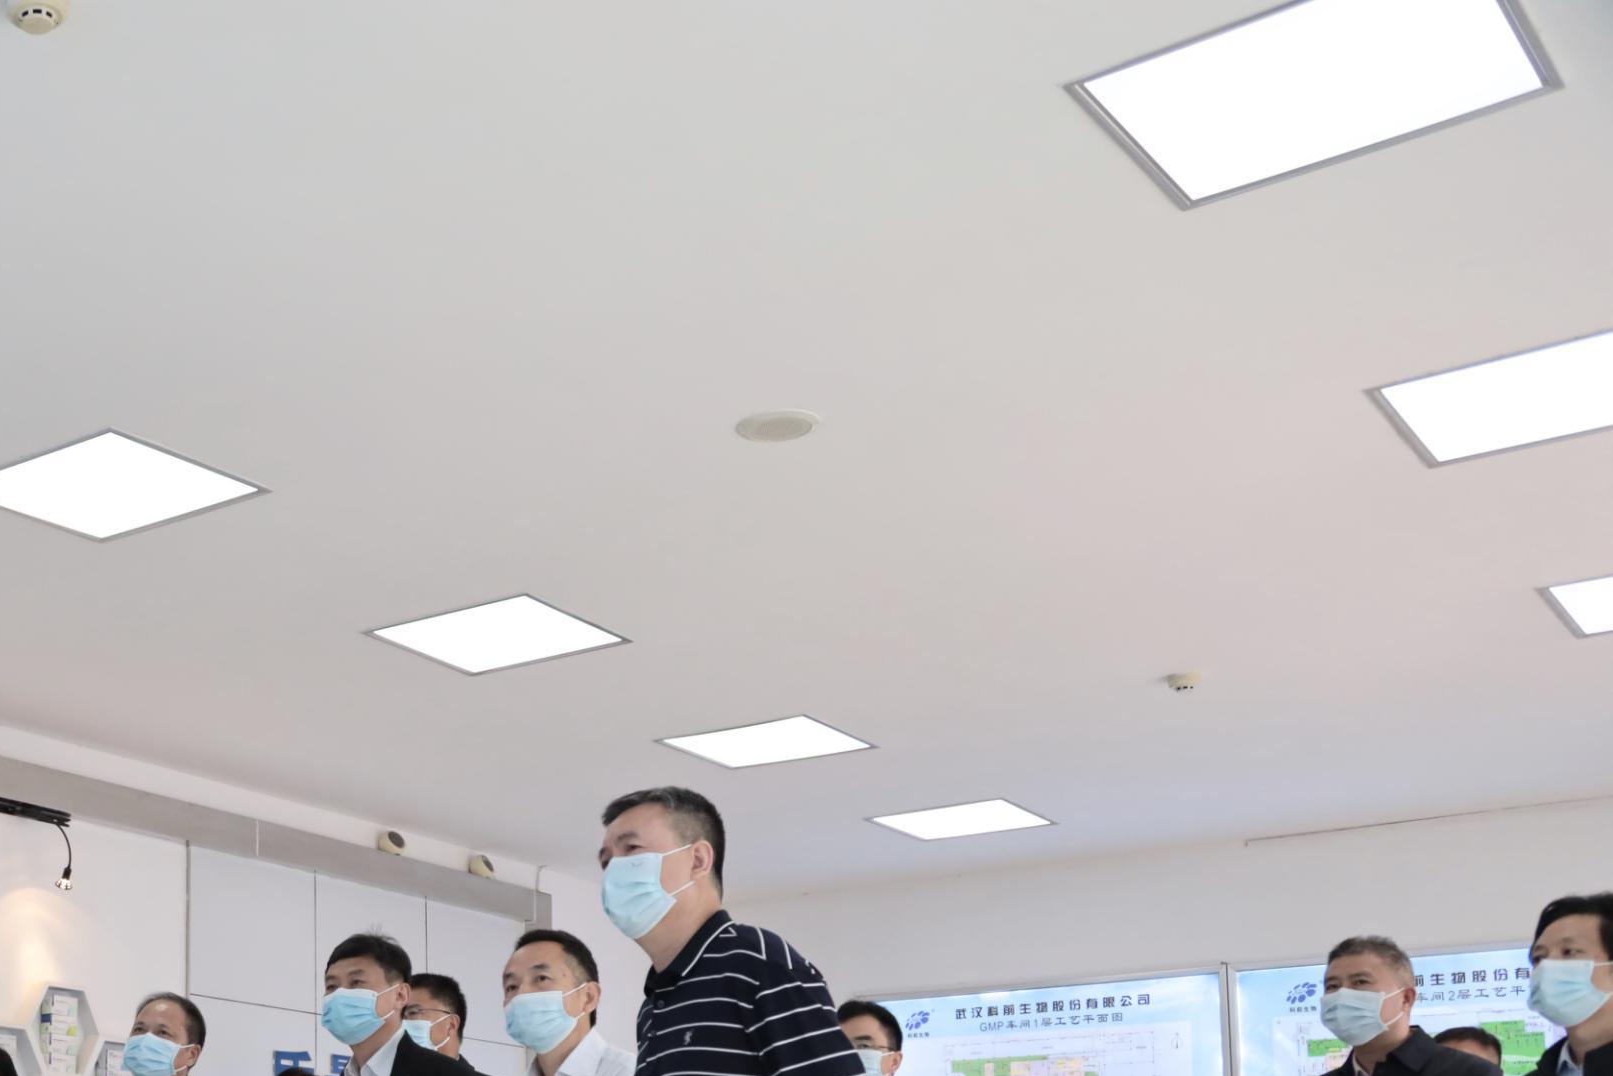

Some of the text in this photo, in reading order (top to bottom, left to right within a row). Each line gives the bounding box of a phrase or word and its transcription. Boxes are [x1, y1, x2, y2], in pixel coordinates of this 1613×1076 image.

[955, 993, 1151, 1020] 武汉科前生物股份有限公司
